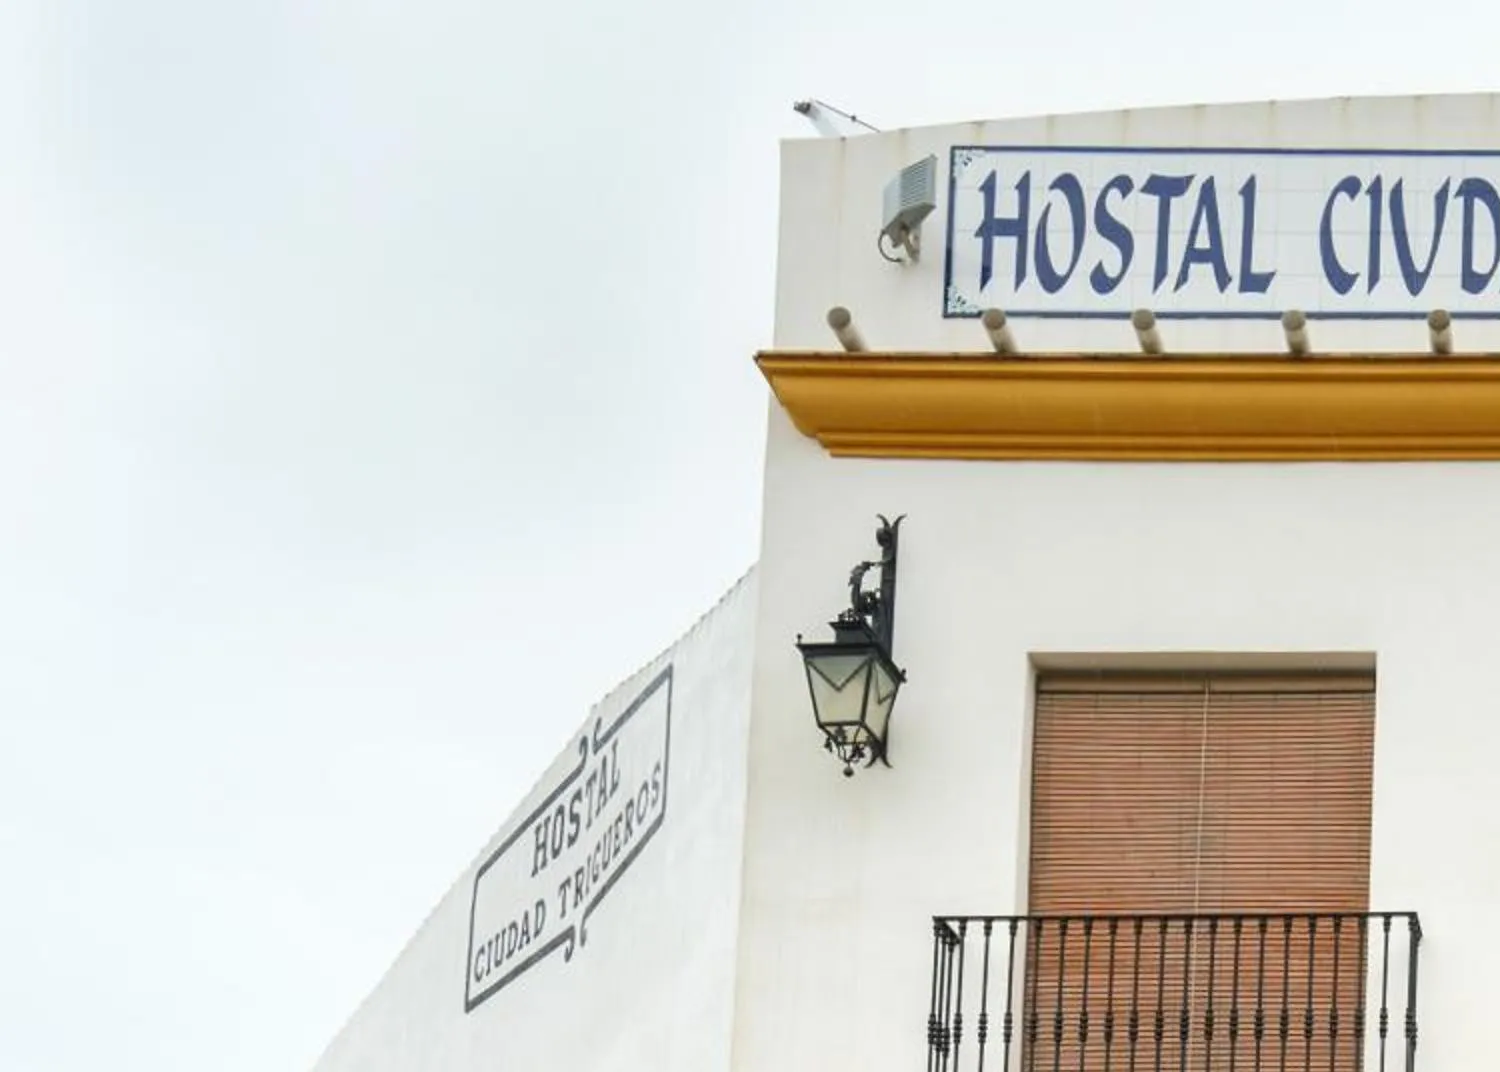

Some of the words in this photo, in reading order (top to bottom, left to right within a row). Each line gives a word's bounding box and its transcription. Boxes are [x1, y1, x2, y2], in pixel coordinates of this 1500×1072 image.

[974, 169, 1278, 295] HOSTAL
[473, 898, 547, 983] CIUDAD
[558, 761, 662, 920] TRIGUEROS
[530, 737, 621, 878] HOSTAL
